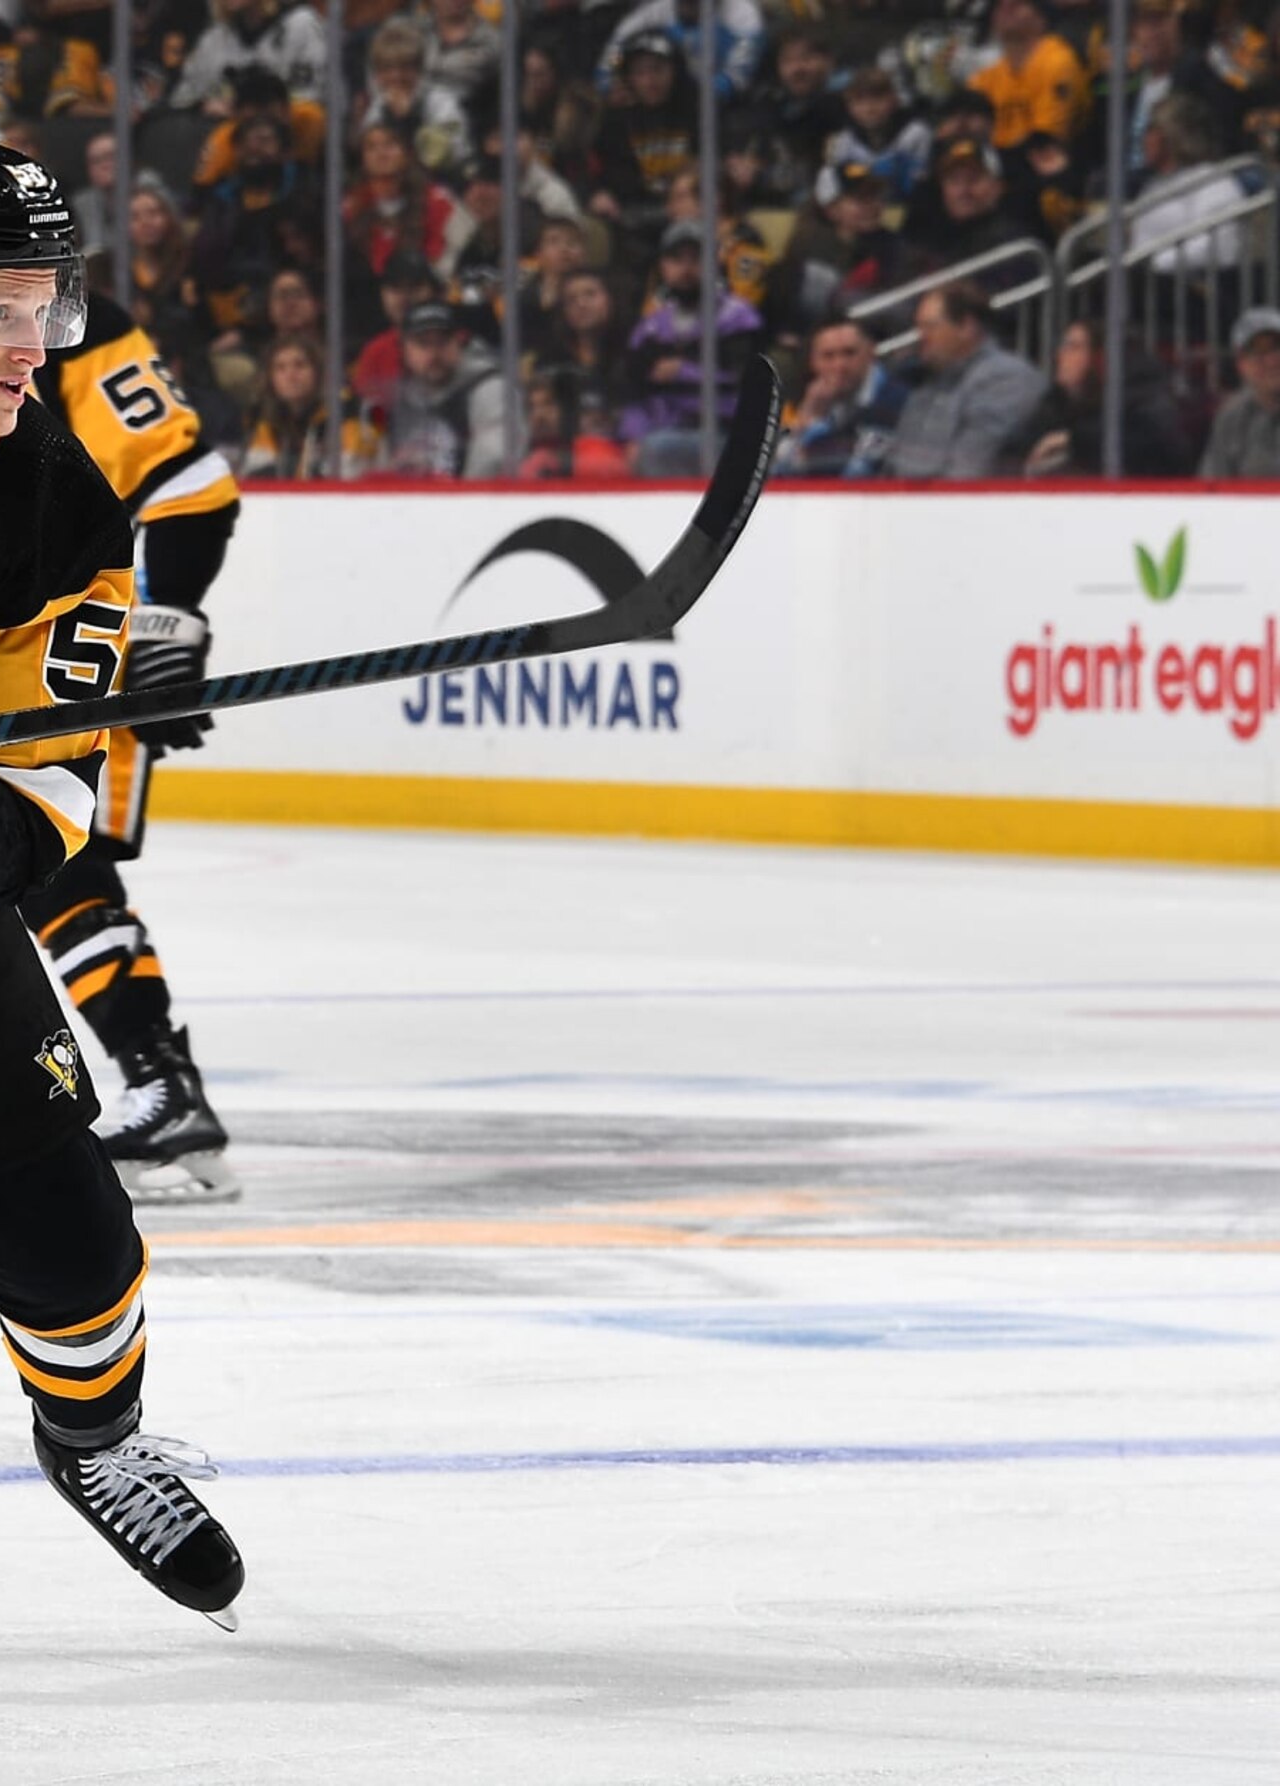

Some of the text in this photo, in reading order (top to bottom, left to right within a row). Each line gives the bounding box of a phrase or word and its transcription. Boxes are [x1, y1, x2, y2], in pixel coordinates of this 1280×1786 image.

[402, 660, 680, 731] JENNMAR
[1006, 614, 1280, 744] giant eagl
